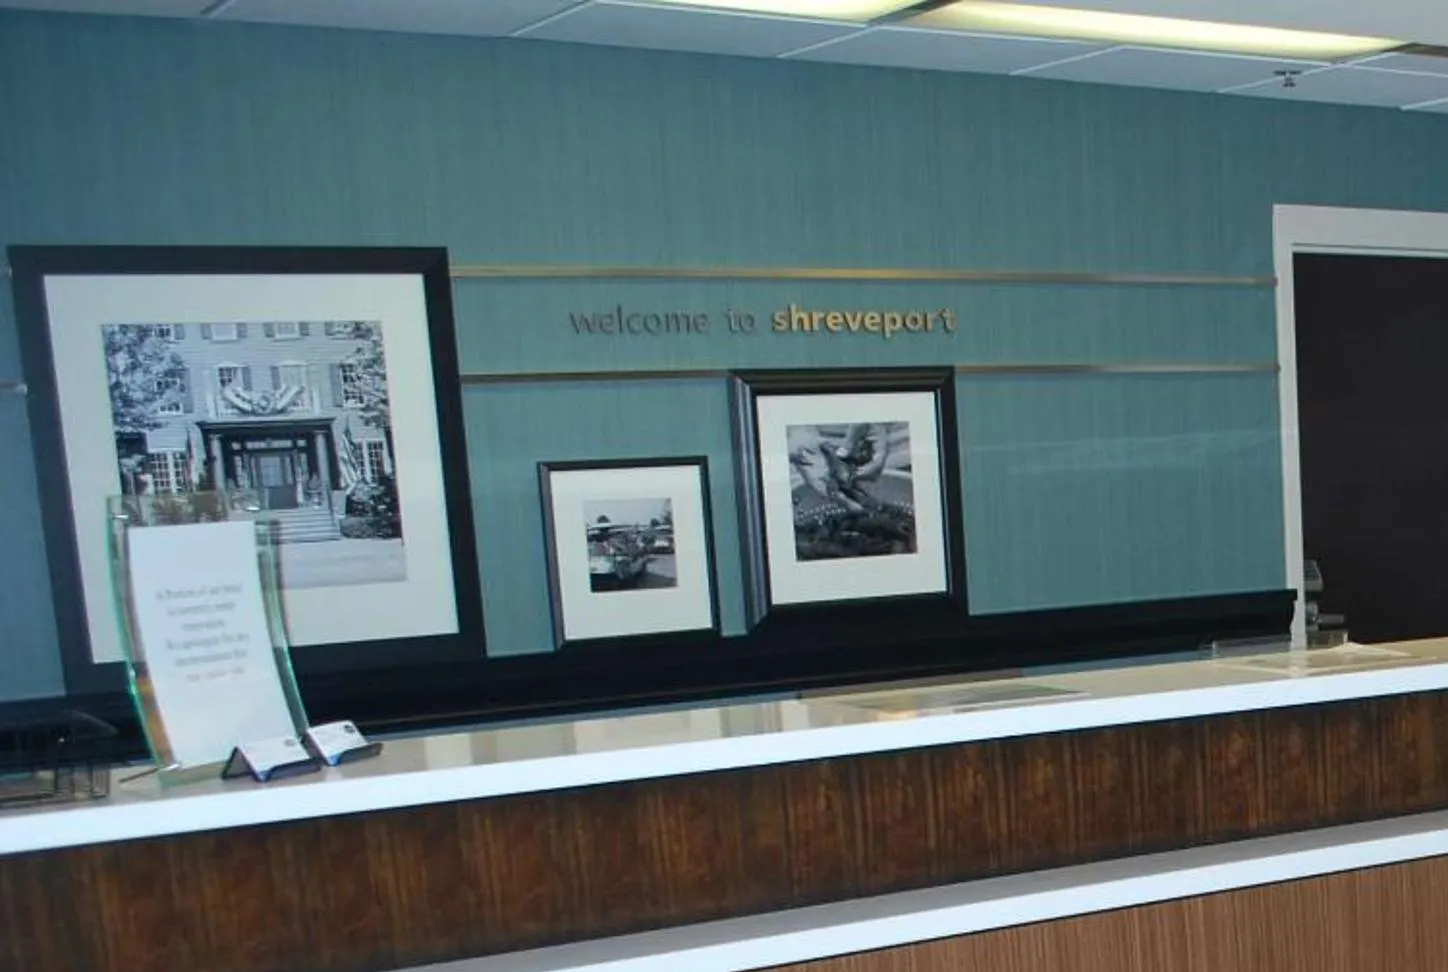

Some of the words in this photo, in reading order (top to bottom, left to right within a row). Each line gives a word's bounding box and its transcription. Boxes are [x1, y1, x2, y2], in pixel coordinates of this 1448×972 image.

[569, 305, 708, 336] welcome
[725, 308, 757, 335] to
[772, 304, 957, 338] shreveport
